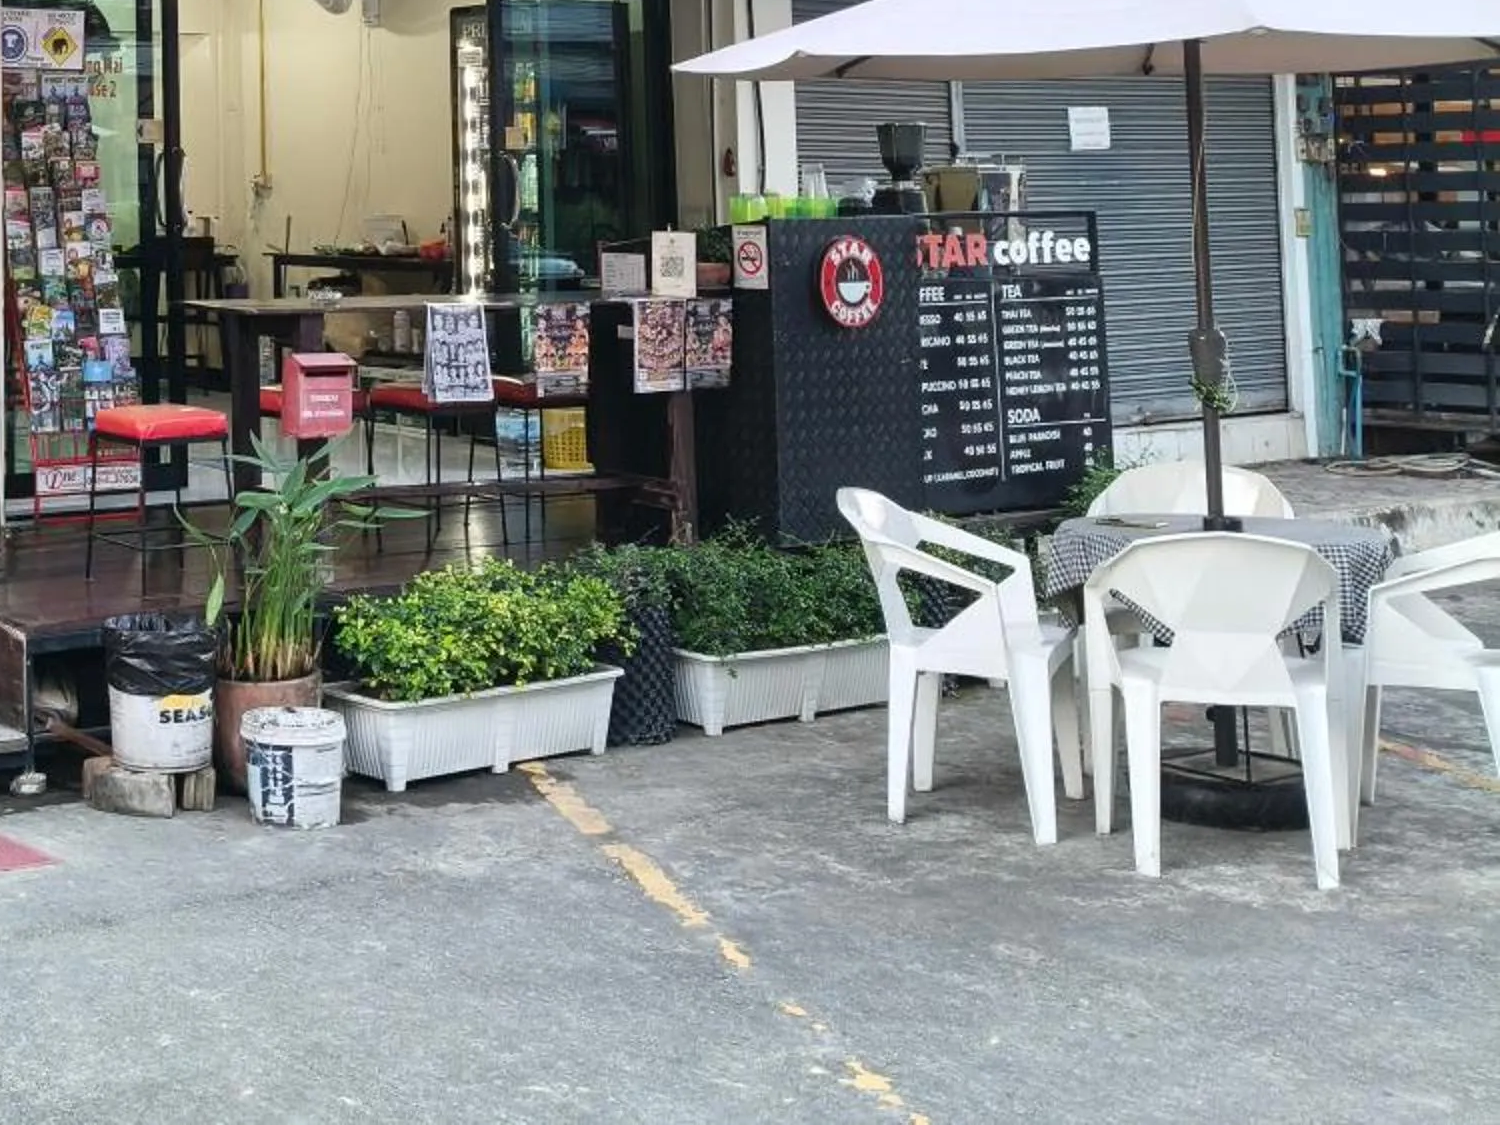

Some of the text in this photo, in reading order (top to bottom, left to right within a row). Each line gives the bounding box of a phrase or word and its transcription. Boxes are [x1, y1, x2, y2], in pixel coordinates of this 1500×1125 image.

[993, 231, 1091, 265] coffee
[1002, 284, 1022, 298] TEA
[1007, 407, 1041, 424] SODA
[159, 708, 212, 724] SEAS
